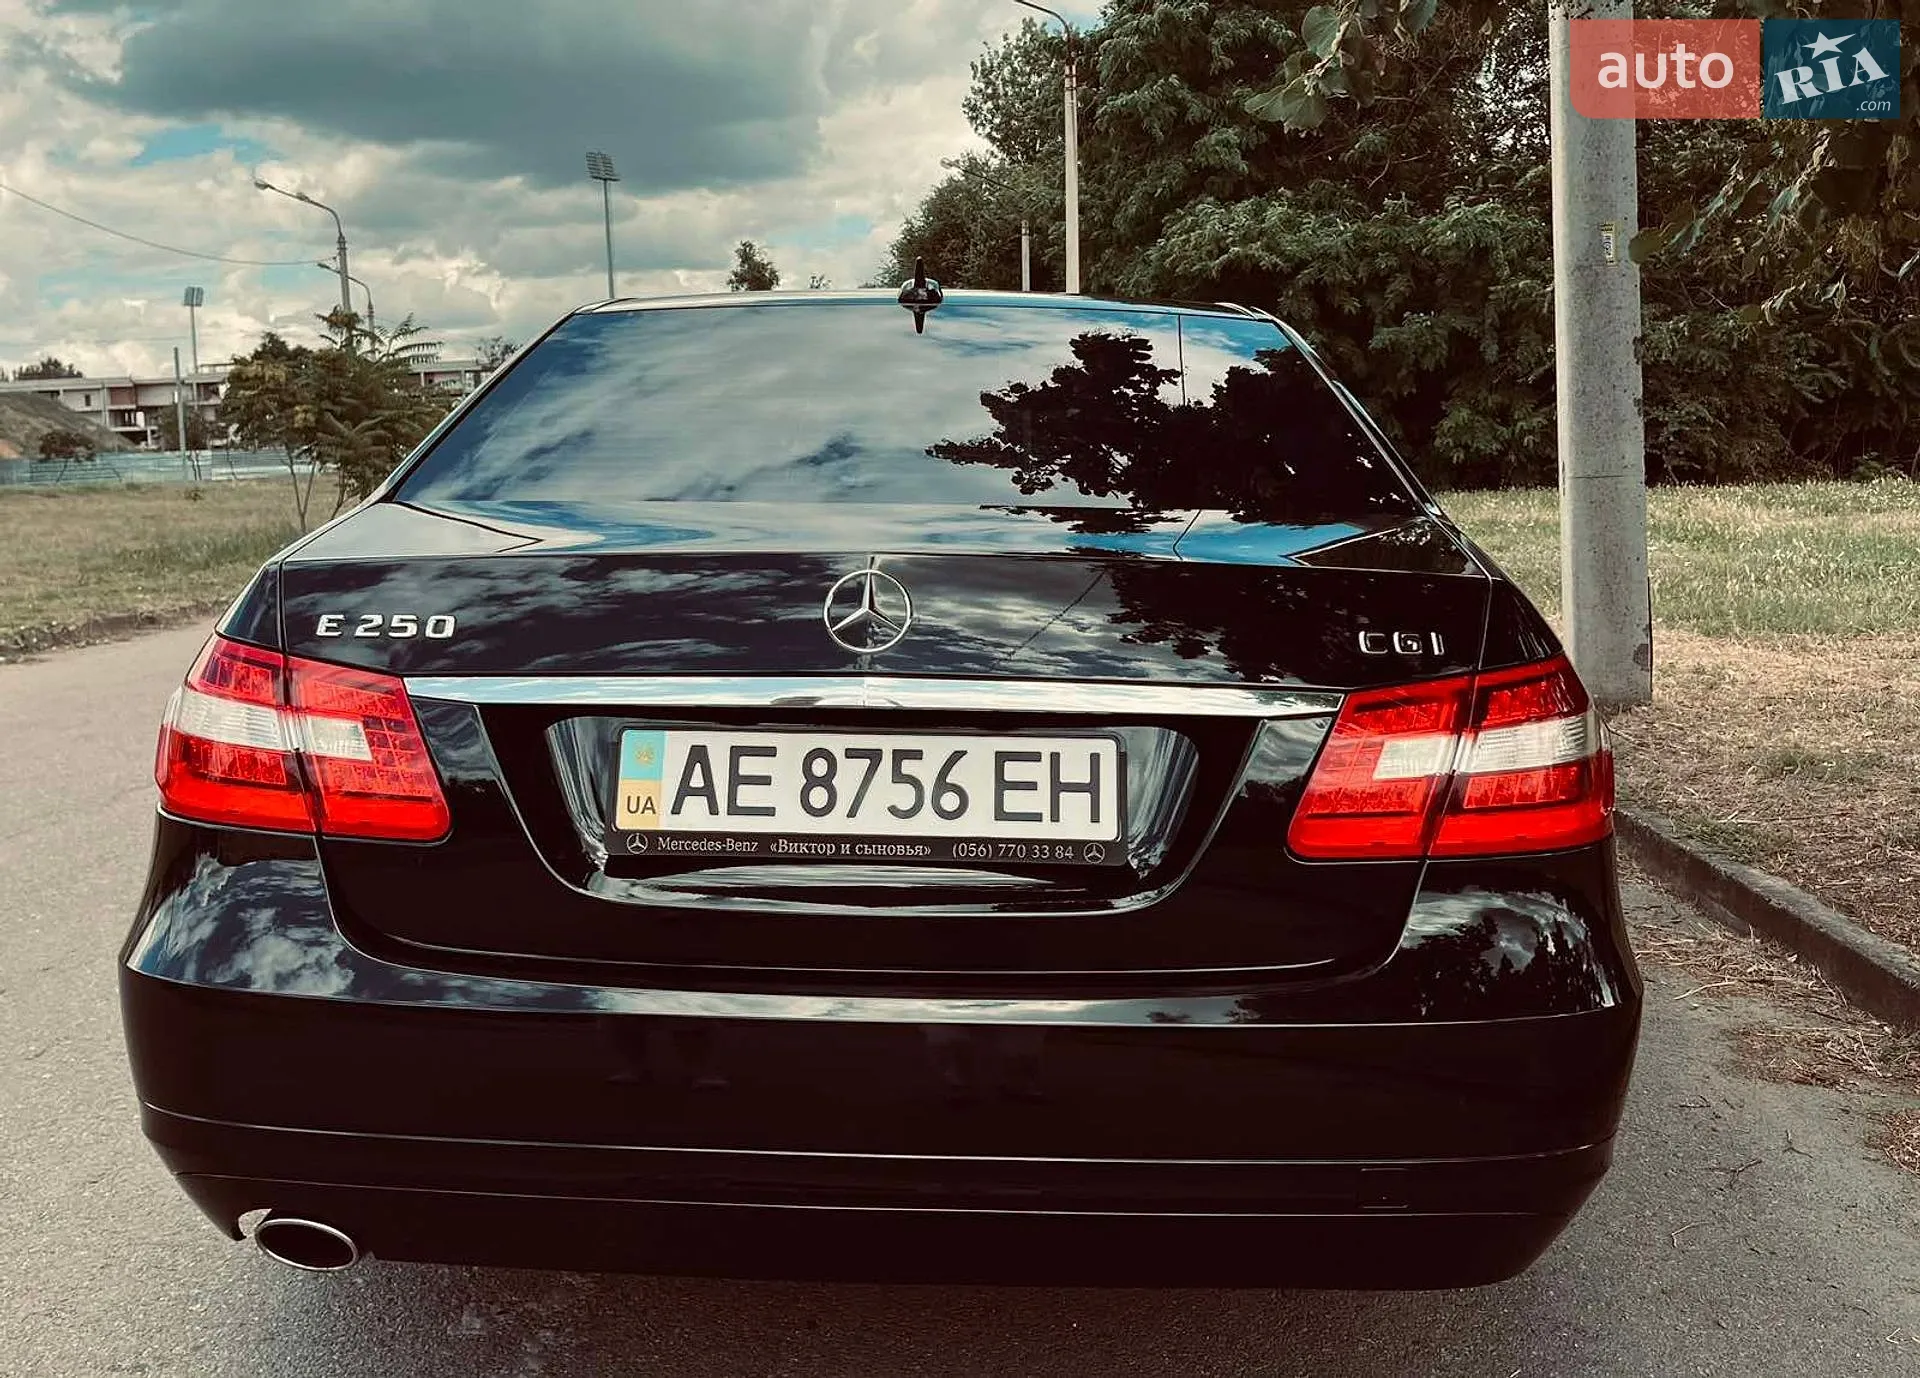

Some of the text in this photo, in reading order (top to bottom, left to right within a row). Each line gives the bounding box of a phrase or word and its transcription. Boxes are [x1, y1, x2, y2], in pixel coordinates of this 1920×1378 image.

[315, 613, 457, 639] E 250
[1358, 630, 1445, 656] CGI
[670, 744, 1102, 824] AE 8756 EH
[626, 795, 657, 816] UA
[656, 836, 759, 853] Mercedes-Benz
[769, 838, 932, 857] «Виктор и сыновья»
[952, 842, 1075, 860] (056) 770 33 84
